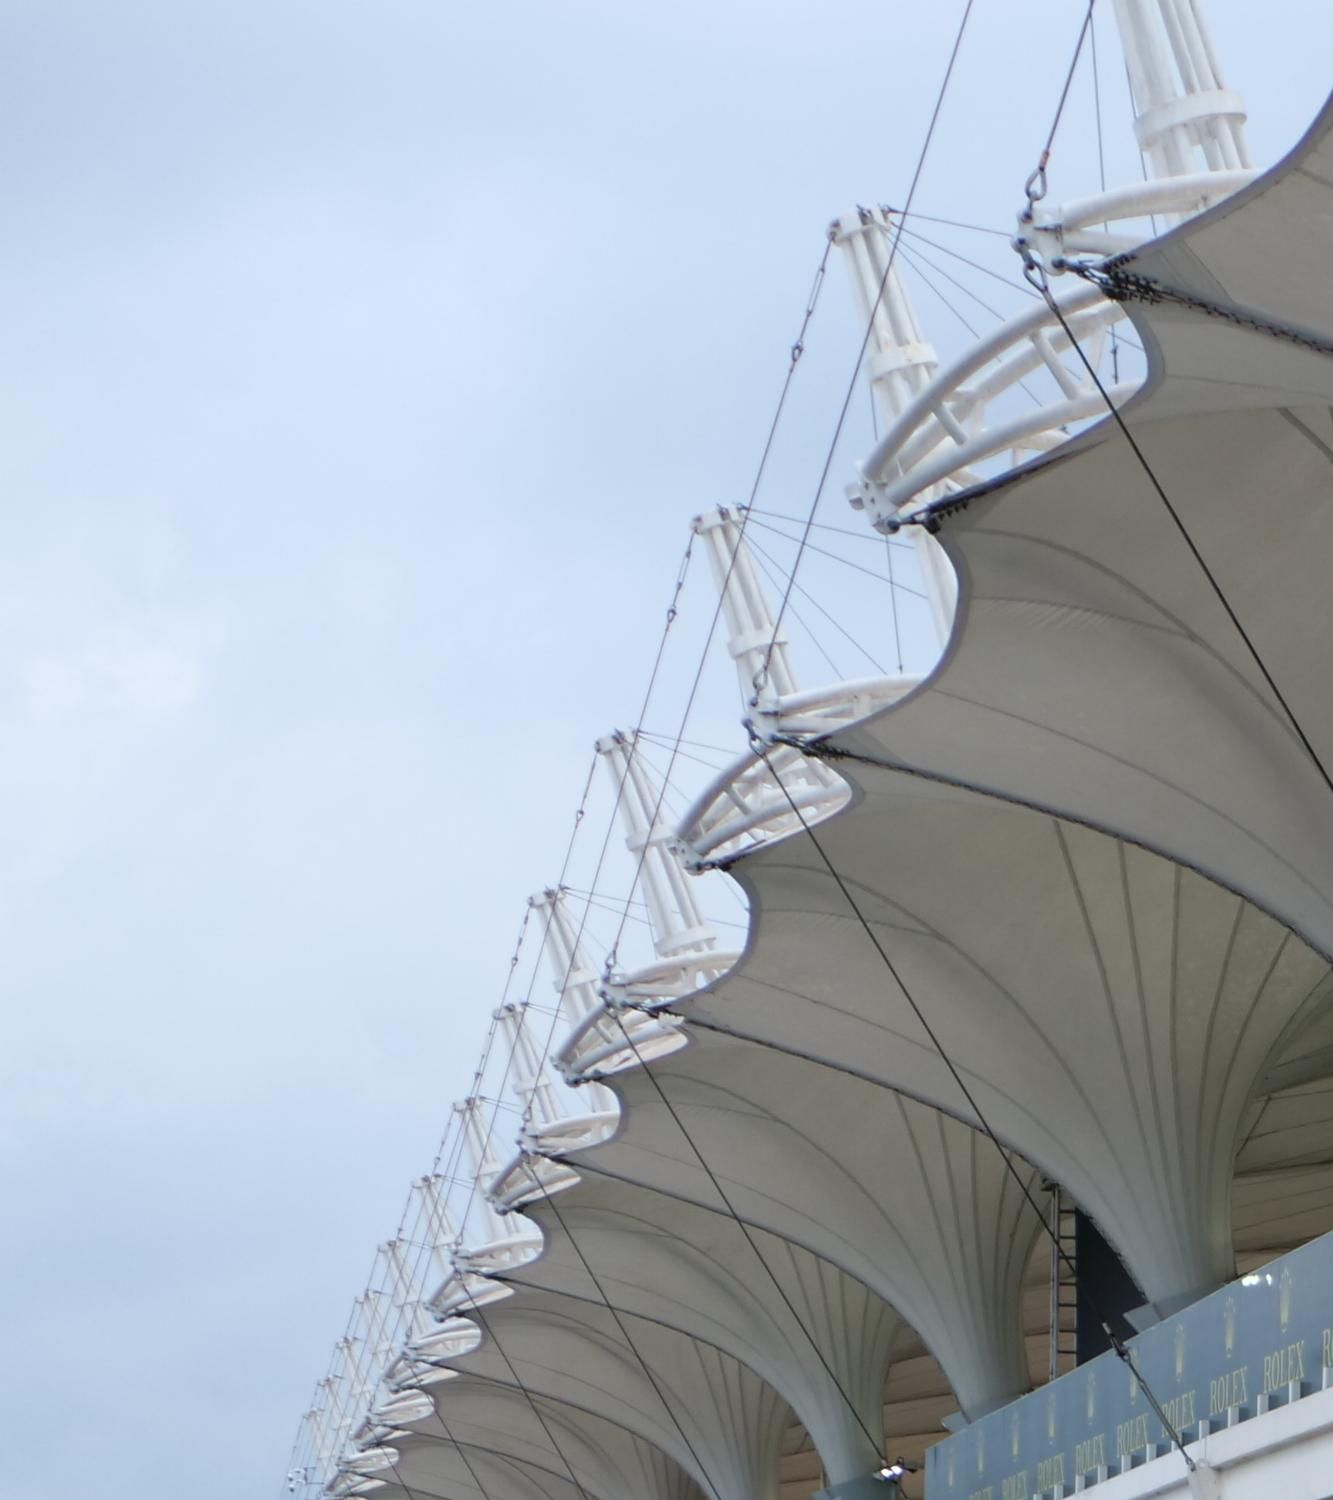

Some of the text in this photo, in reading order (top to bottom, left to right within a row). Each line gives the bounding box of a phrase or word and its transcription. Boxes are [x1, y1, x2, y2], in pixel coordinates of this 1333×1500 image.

[1210, 1367, 1248, 1416] ROLEX
[1263, 1341, 1305, 1395] ROLEX
[1117, 1414, 1149, 1457] ROLEX
[1161, 1390, 1196, 1438] ROLEX
